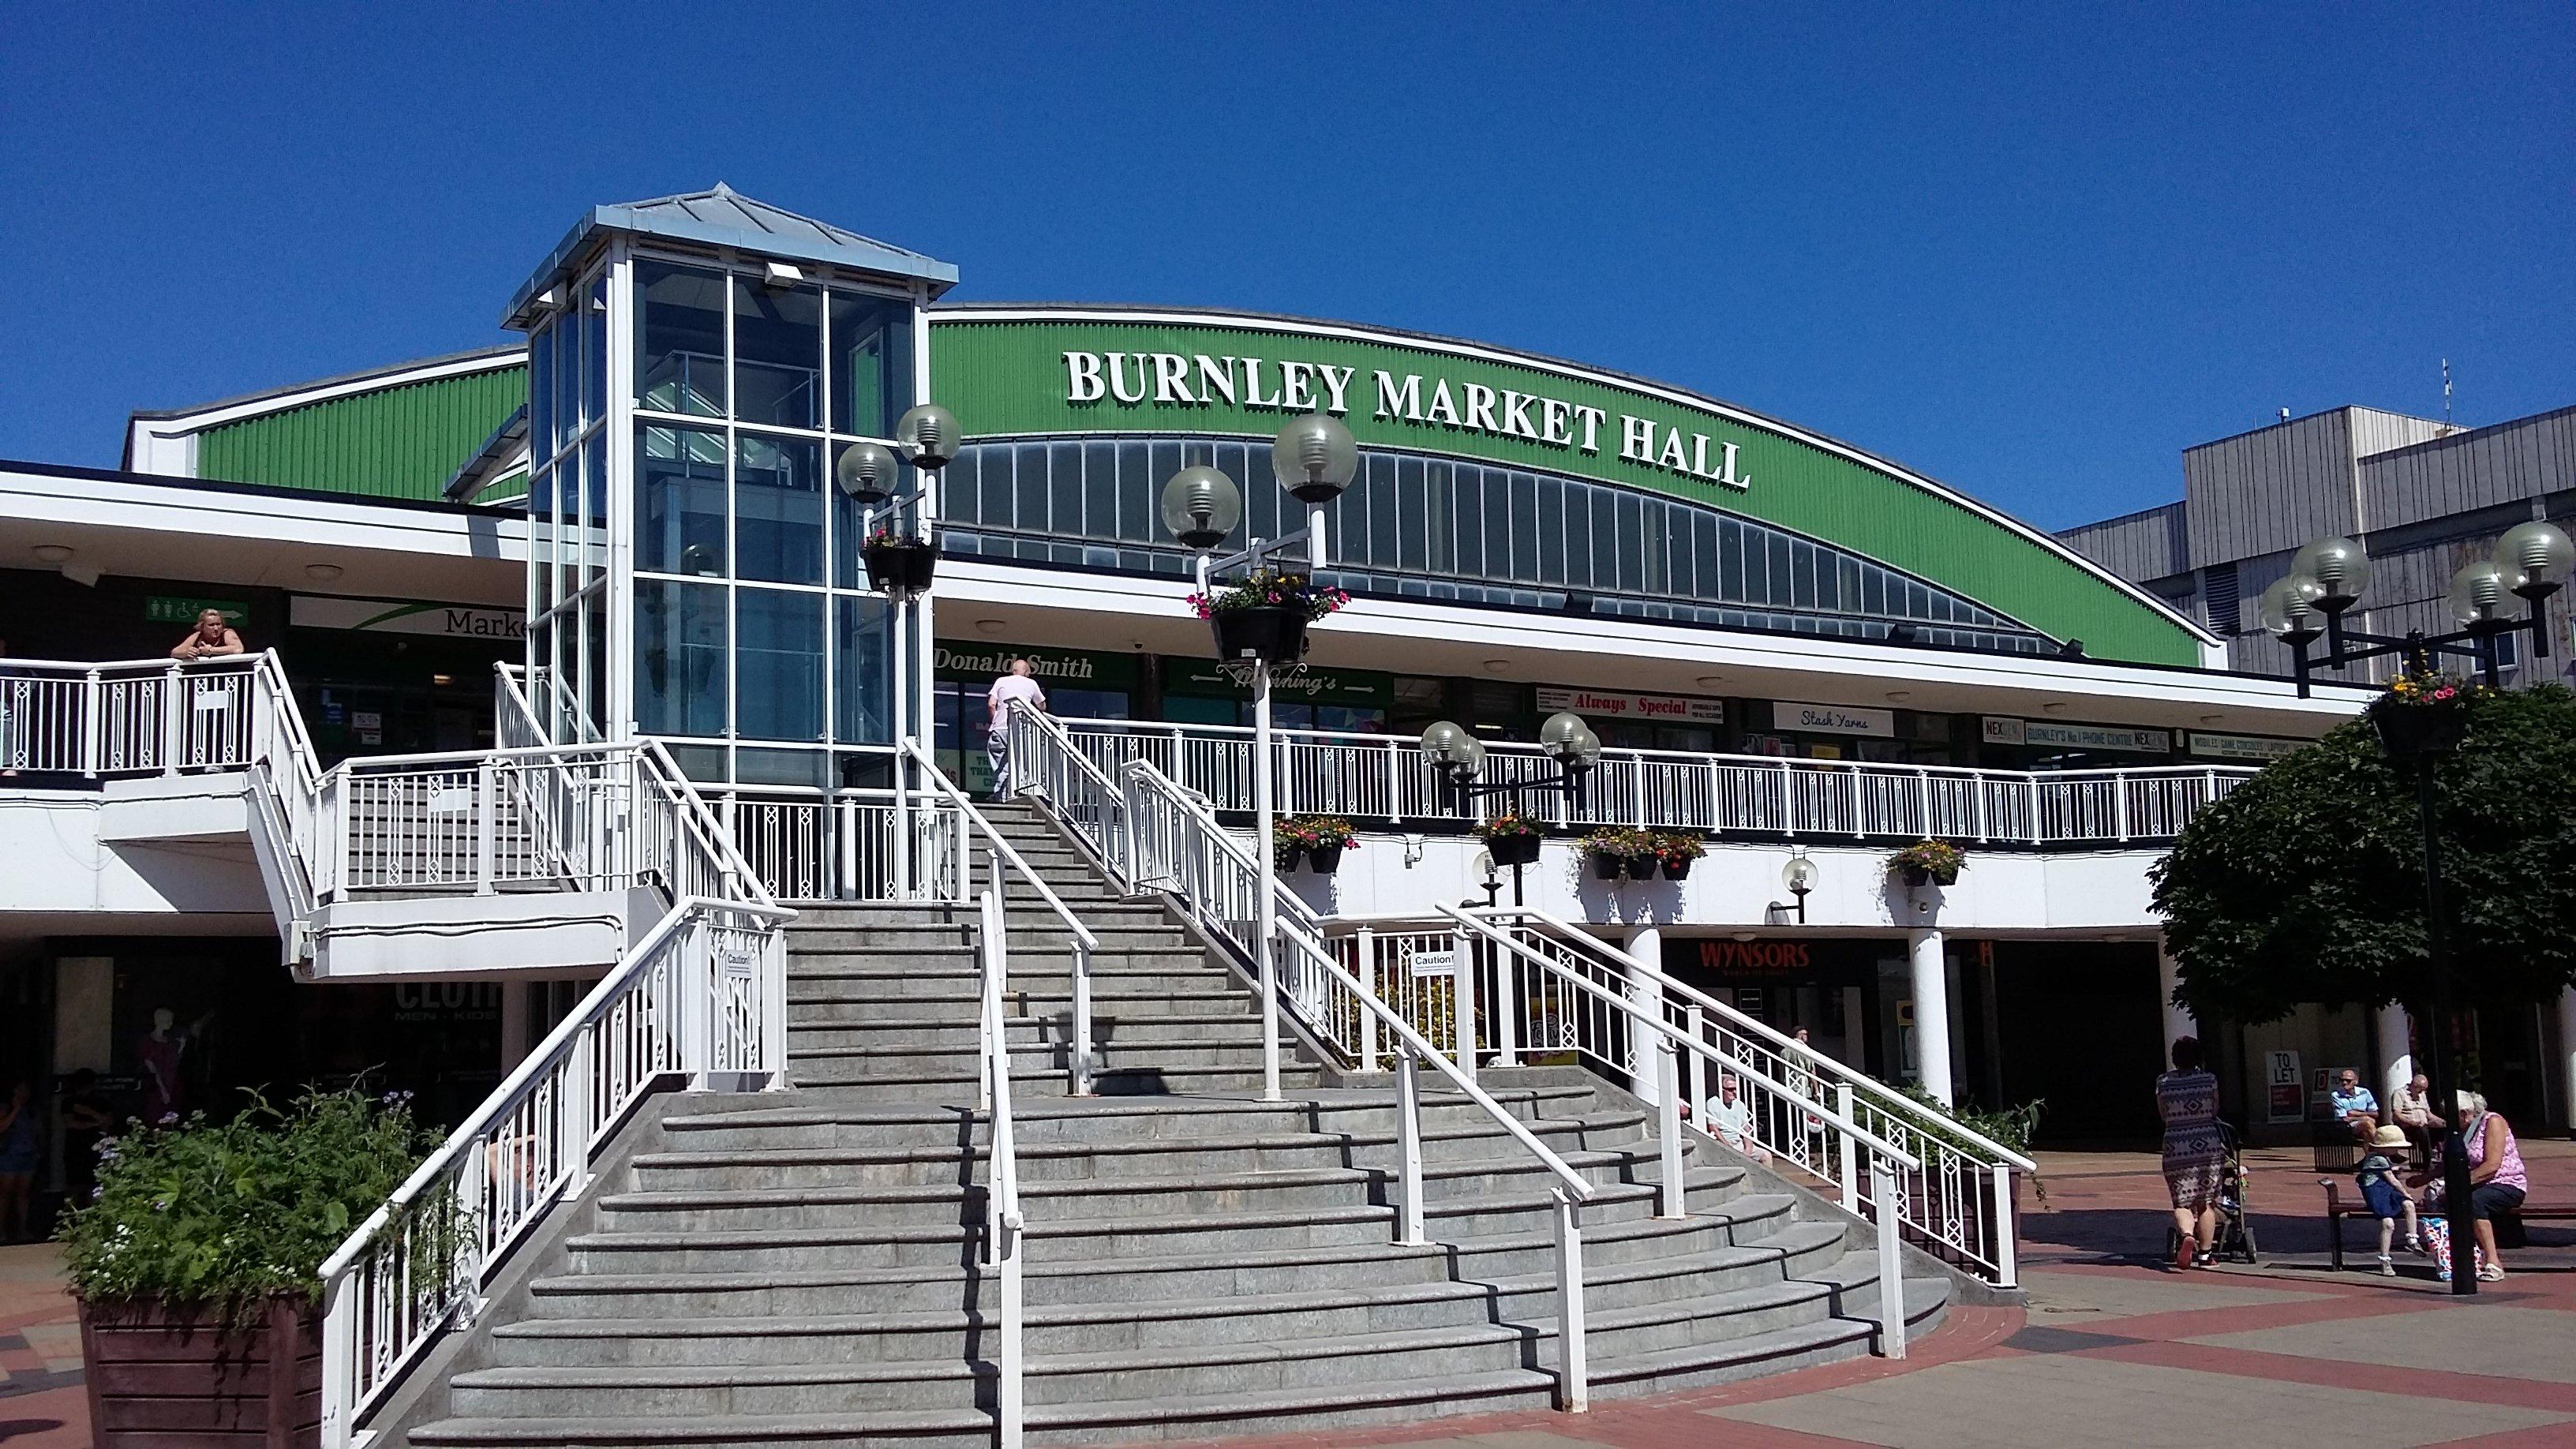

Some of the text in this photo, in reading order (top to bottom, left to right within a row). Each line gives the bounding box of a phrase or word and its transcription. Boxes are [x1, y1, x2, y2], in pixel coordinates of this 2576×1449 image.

[1062, 350, 1751, 489] BURNLEY MARKET HALL
[933, 647, 1093, 678] Donald Smith
[1574, 693, 1627, 713] Always
[1638, 697, 1687, 716] Special
[1800, 710, 1868, 728] Stash Yarns
[1699, 942, 1810, 968] WYNSORS
[395, 1011, 437, 1021] MEN
[2275, 1053, 2290, 1068] TO
[2274, 1067, 2295, 1083] LET
